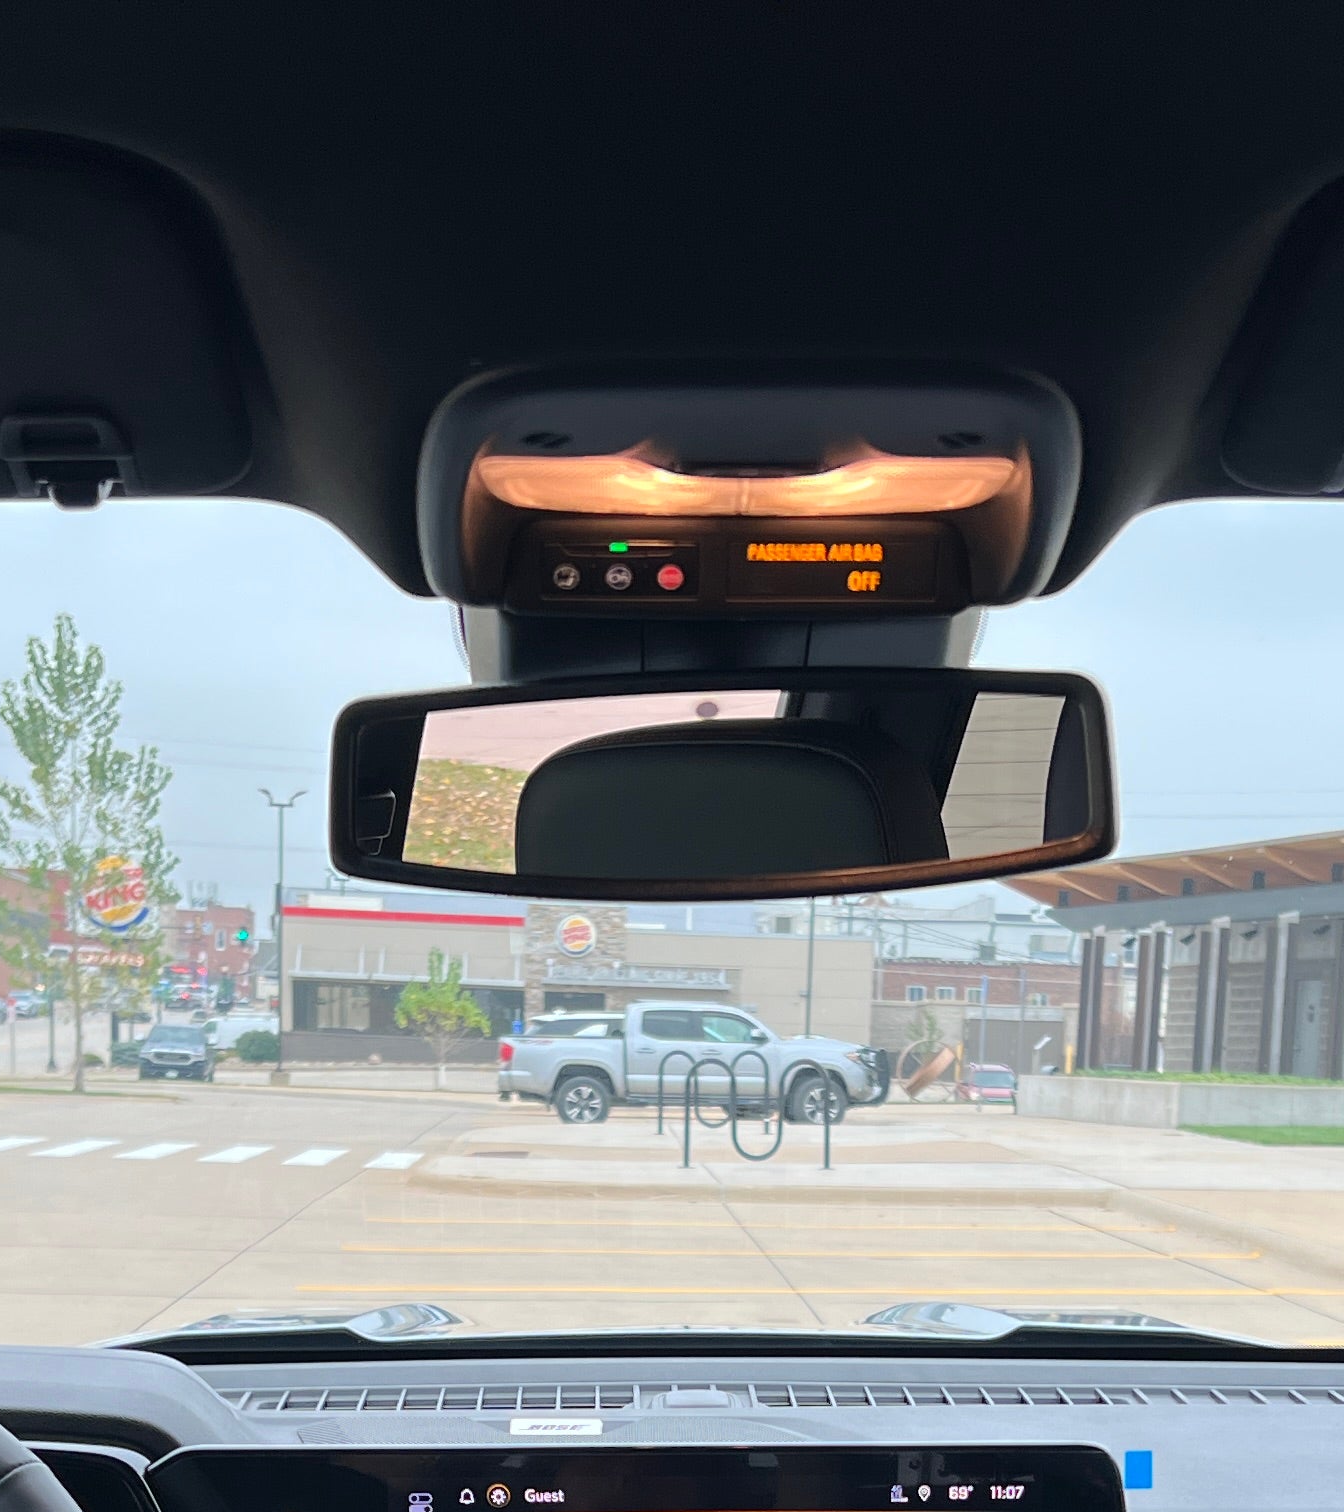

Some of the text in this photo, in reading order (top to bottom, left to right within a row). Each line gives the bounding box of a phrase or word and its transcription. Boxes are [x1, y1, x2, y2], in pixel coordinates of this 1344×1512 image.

[747, 543, 826, 562] PASSENGER
[847, 570, 881, 592] OFF
[524, 1488, 565, 1504] Guest
[990, 1485, 1025, 1500] 11:07
